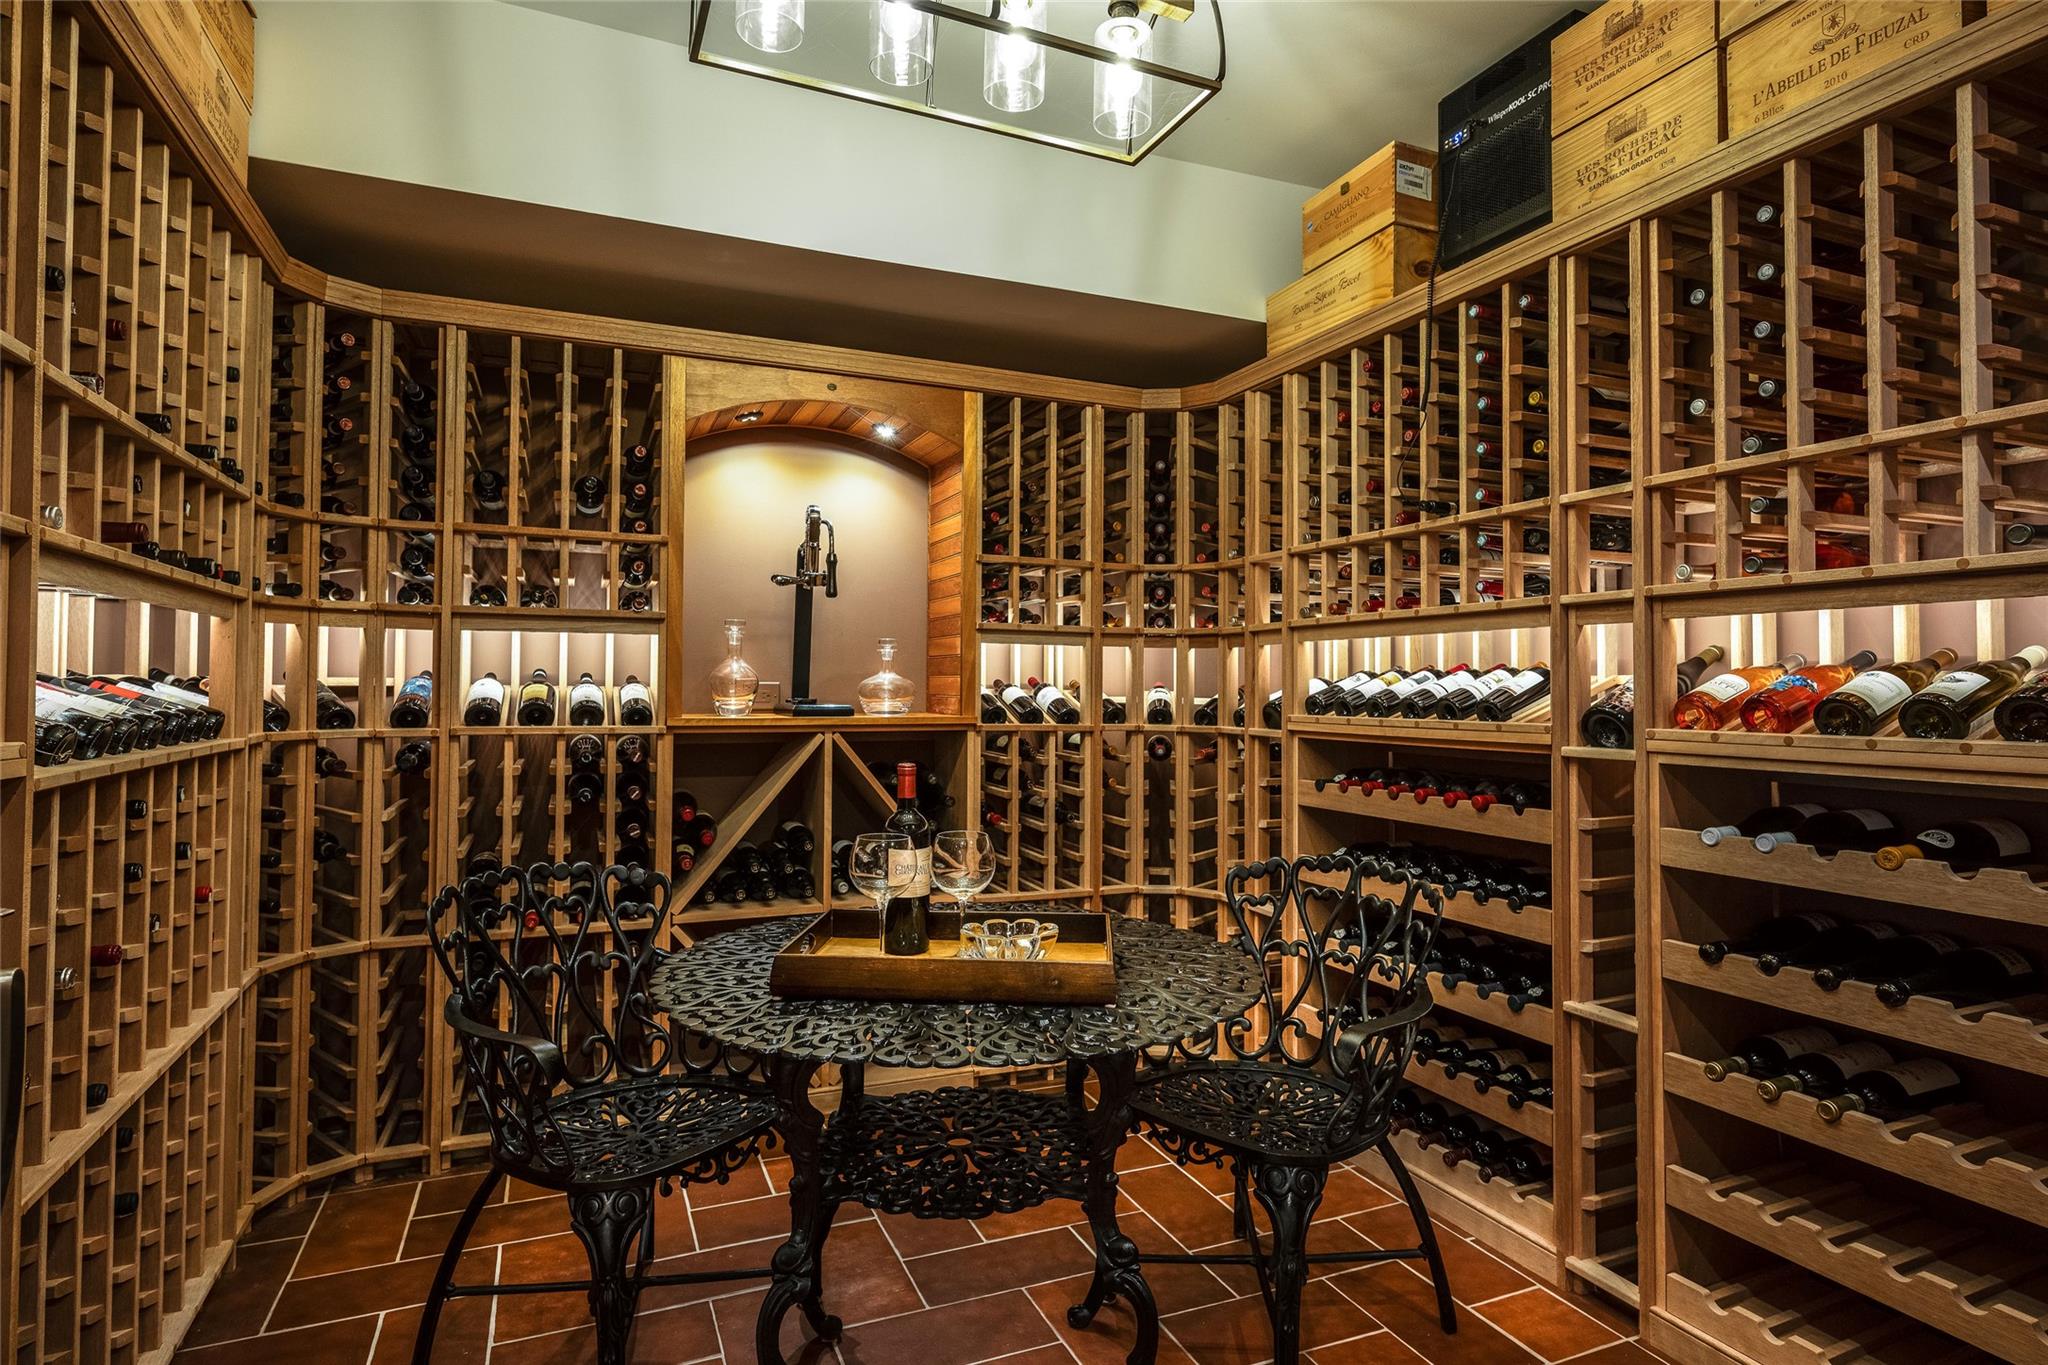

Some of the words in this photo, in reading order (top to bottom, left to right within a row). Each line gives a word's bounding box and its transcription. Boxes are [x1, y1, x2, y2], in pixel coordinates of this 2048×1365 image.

[1573, 58, 1598, 78] LES
[1601, 23, 1655, 60] ROCHES
[1659, 8, 1680, 25] DE
[1903, 30, 1930, 49] CRD
[1574, 19, 1679, 88] YON-FIGEAC
[1627, 50, 1651, 67] GRAND
[1650, 41, 1665, 55] CRU
[1752, 57, 1828, 108] L'ABEILLE
[1830, 46, 1850, 67] DE
[1853, 6, 1930, 55] FIEUZAL
[1823, 71, 1849, 90] 2010
[1527, 88, 1538, 100] SC
[1753, 112, 1761, 124] 6
[1576, 159, 1601, 178] LES
[1604, 127, 1658, 160] ROCHES
[1662, 114, 1682, 131] DE
[1576, 125, 1682, 187] YON-FIGEAC
[1630, 154, 1653, 171] GRAND
[1654, 147, 1668, 159] CRU
